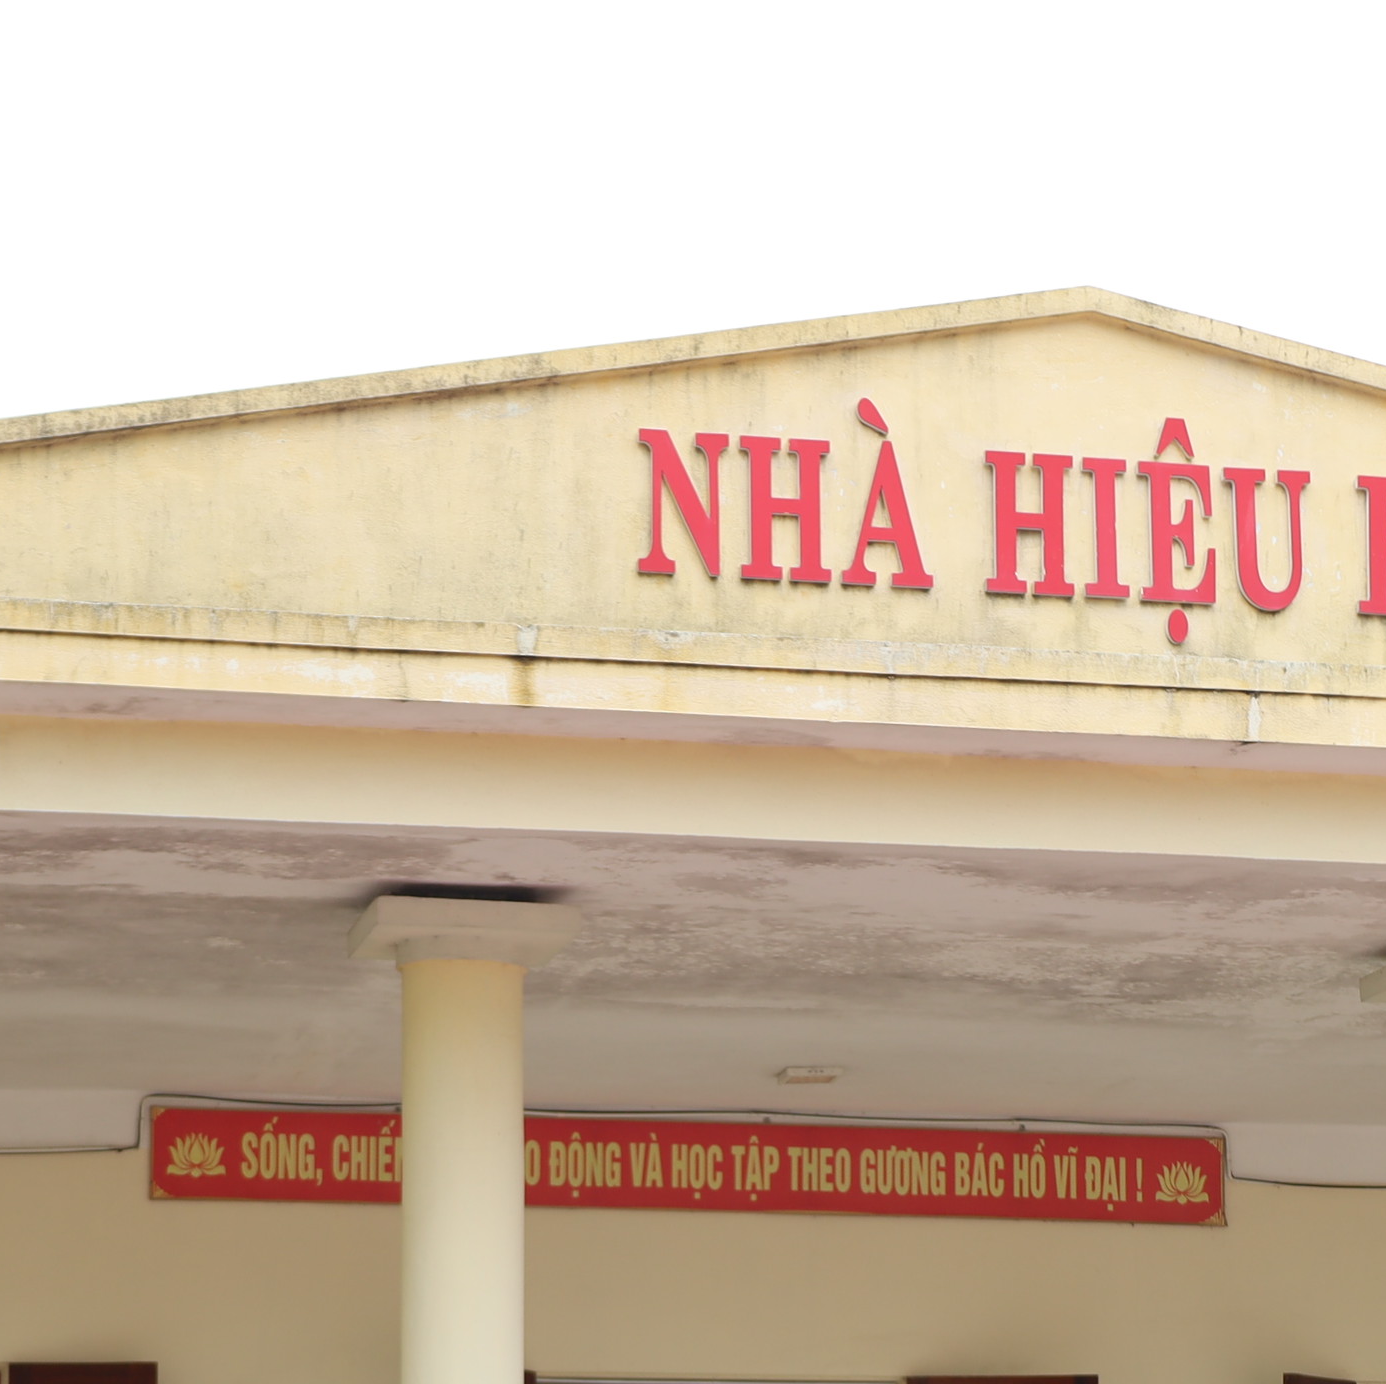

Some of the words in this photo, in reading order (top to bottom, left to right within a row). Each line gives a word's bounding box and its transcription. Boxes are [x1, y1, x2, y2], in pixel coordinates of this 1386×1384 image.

[637, 397, 935, 589] NHÀ
[984, 417, 1314, 645] HIỆU
[240, 1116, 323, 1186] SỐNG,
[547, 1132, 622, 1198] ĐỘNG
[629, 1132, 664, 1188] VÀ
[671, 1143, 723, 1200] HỌC
[731, 1135, 780, 1201] TẬP
[787, 1146, 852, 1193] THEO
[859, 1145, 946, 1196] GƯƠNG
[954, 1142, 1005, 1198] BÁC
[1013, 1138, 1046, 1199] HỒ
[1053, 1146, 1078, 1200] VĨ
[1084, 1156, 1127, 1212] ĐẠI
